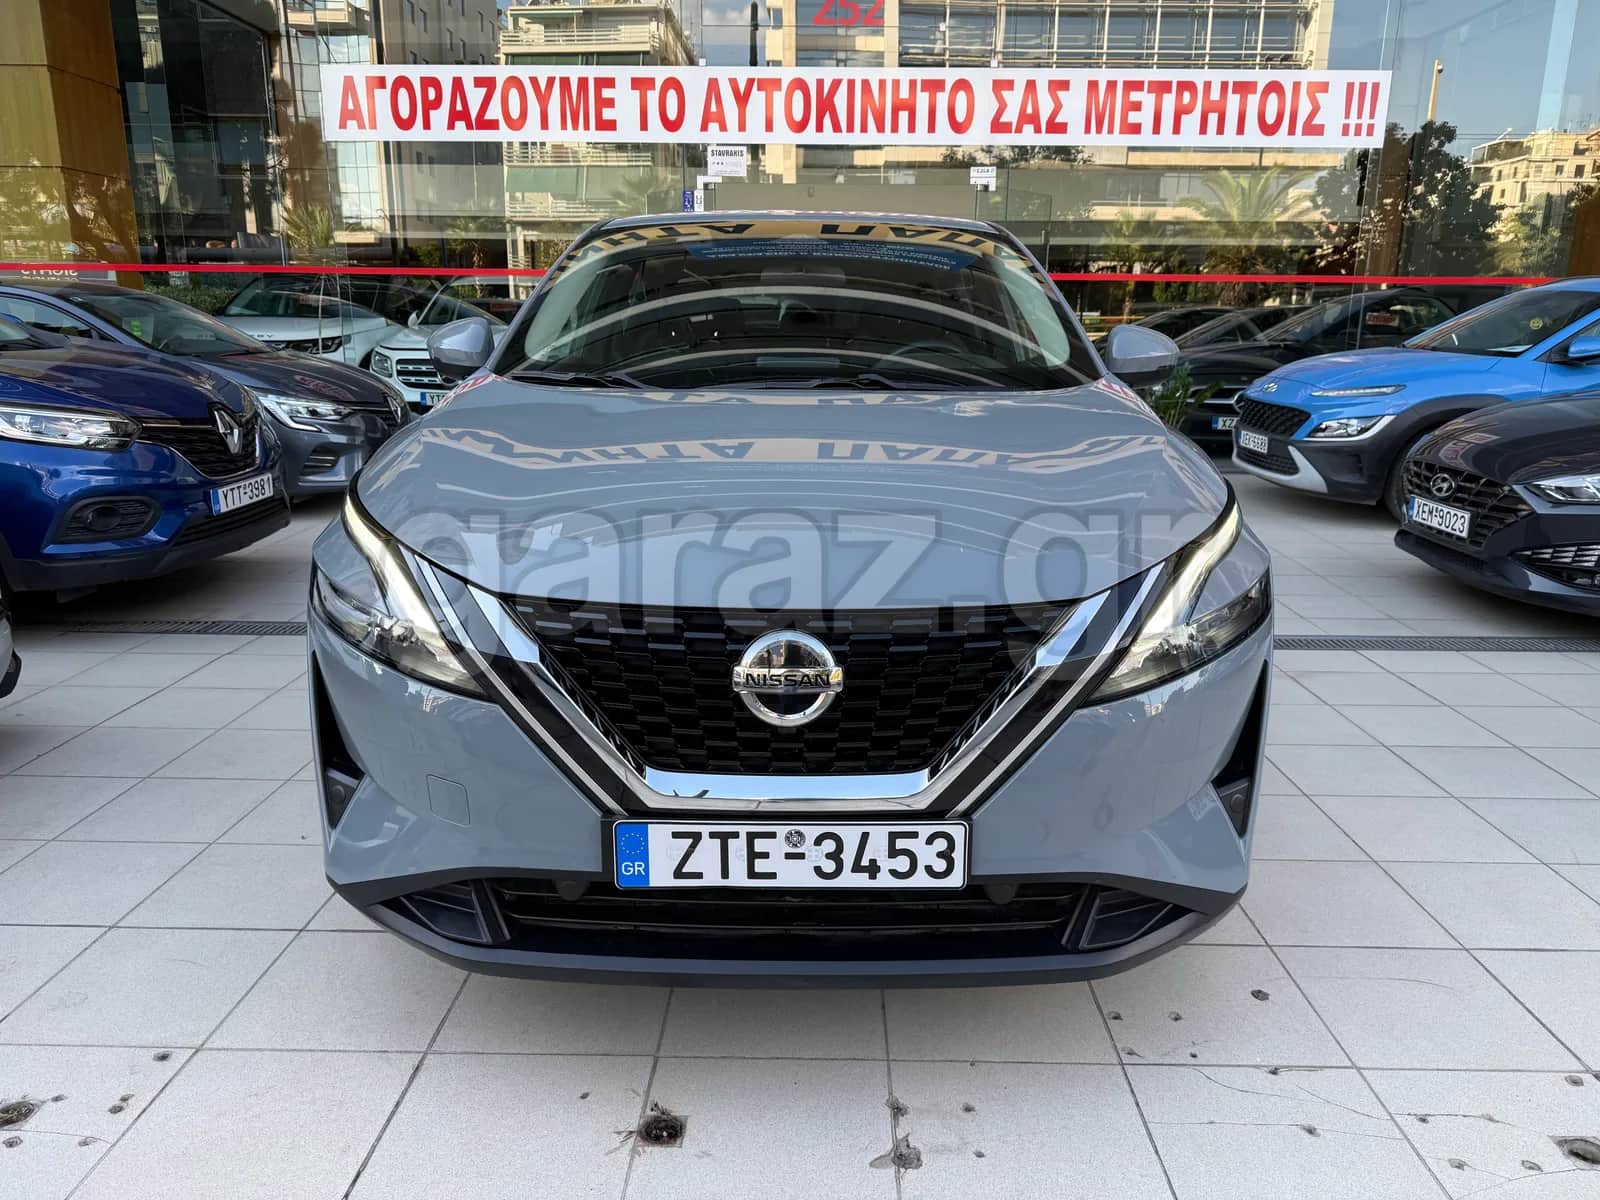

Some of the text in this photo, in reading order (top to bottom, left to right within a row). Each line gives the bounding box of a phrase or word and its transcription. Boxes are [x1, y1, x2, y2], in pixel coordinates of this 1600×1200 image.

[338, 74, 1381, 138] ΑΓΟΡΑΖΟΥΜΕ ΤΟ ΑΥΤΟΚΙΝΗΤΟ ΣΑΣ ΜΕΤΡΗΤΟΙΣ !!!
[745, 672, 831, 688] NISSAN
[621, 861, 646, 876] GR
[671, 830, 956, 881] ZTE-3453
